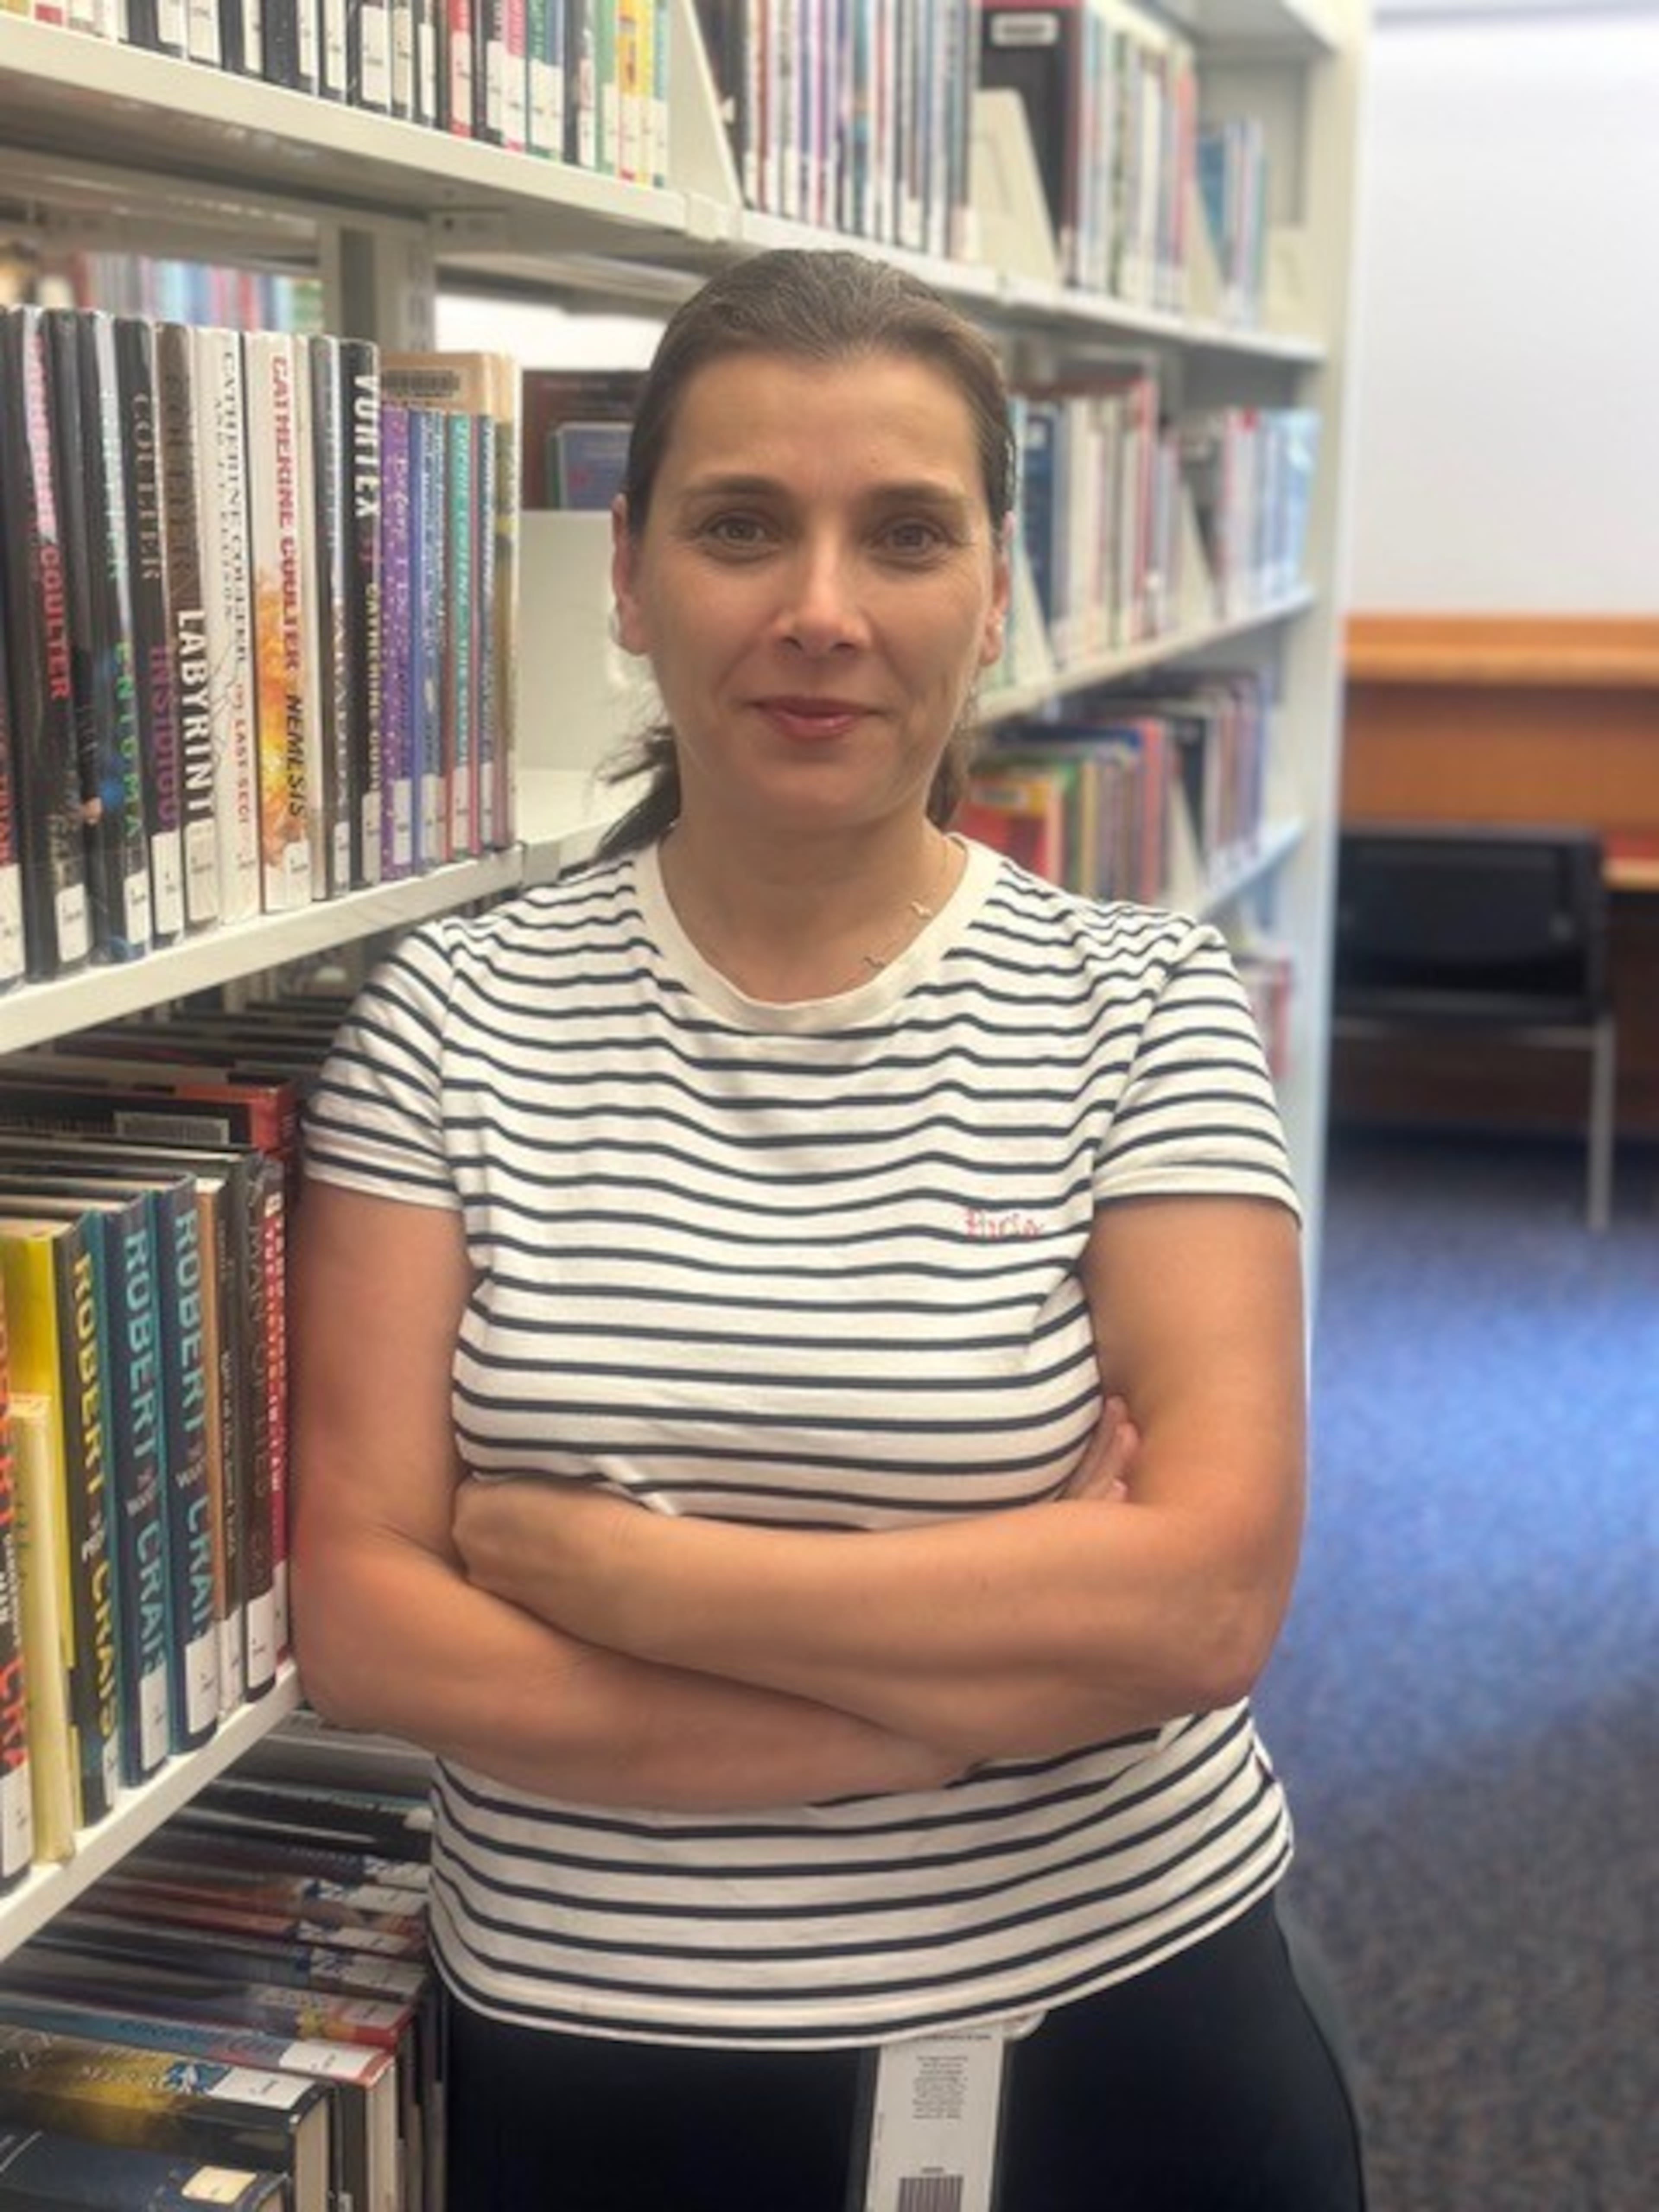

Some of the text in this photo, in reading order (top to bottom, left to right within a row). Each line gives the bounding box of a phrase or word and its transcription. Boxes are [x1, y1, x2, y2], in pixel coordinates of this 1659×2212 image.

[132, 392, 162, 580] COULTER
[223, 352, 245, 527] CATHERINE
[271, 356, 301, 671] CATHERINE COULTER
[354, 374, 381, 518] VORTEX
[40, 545, 73, 700] COULTER
[232, 535, 248, 664] COULTER
[366, 583, 382, 720] CATHERINE
[178, 608, 214, 813] LABYRINT
[234, 719, 248, 768] LAST
[285, 694, 308, 817] NEMESIS
[124, 1228, 156, 1459] ROBERT
[175, 1211, 207, 1431] ROBERT
[248, 1225, 264, 1323] MAN
[74, 1254, 104, 1494] ROBERT
